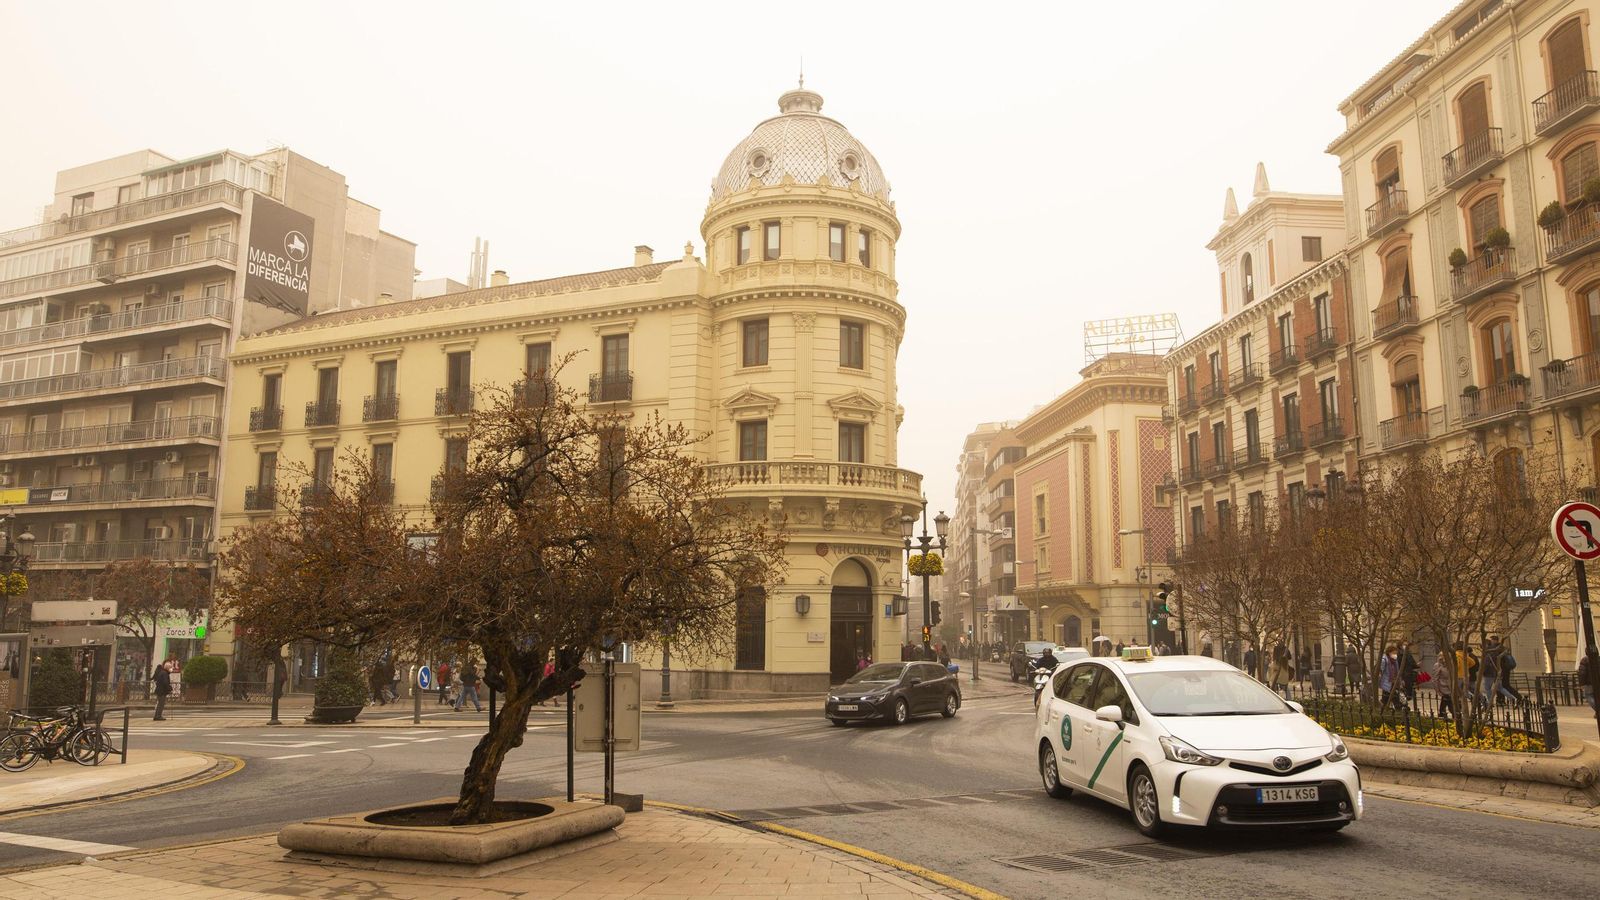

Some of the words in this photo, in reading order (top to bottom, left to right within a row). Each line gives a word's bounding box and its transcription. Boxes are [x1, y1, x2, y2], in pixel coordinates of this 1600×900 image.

[248, 261, 308, 293] DIFERENCIA
[249, 246, 292, 275] MARCA
[294, 263, 309, 281] LA
[1265, 789, 1292, 801] 1314
[1294, 788, 1316, 800] KSG
